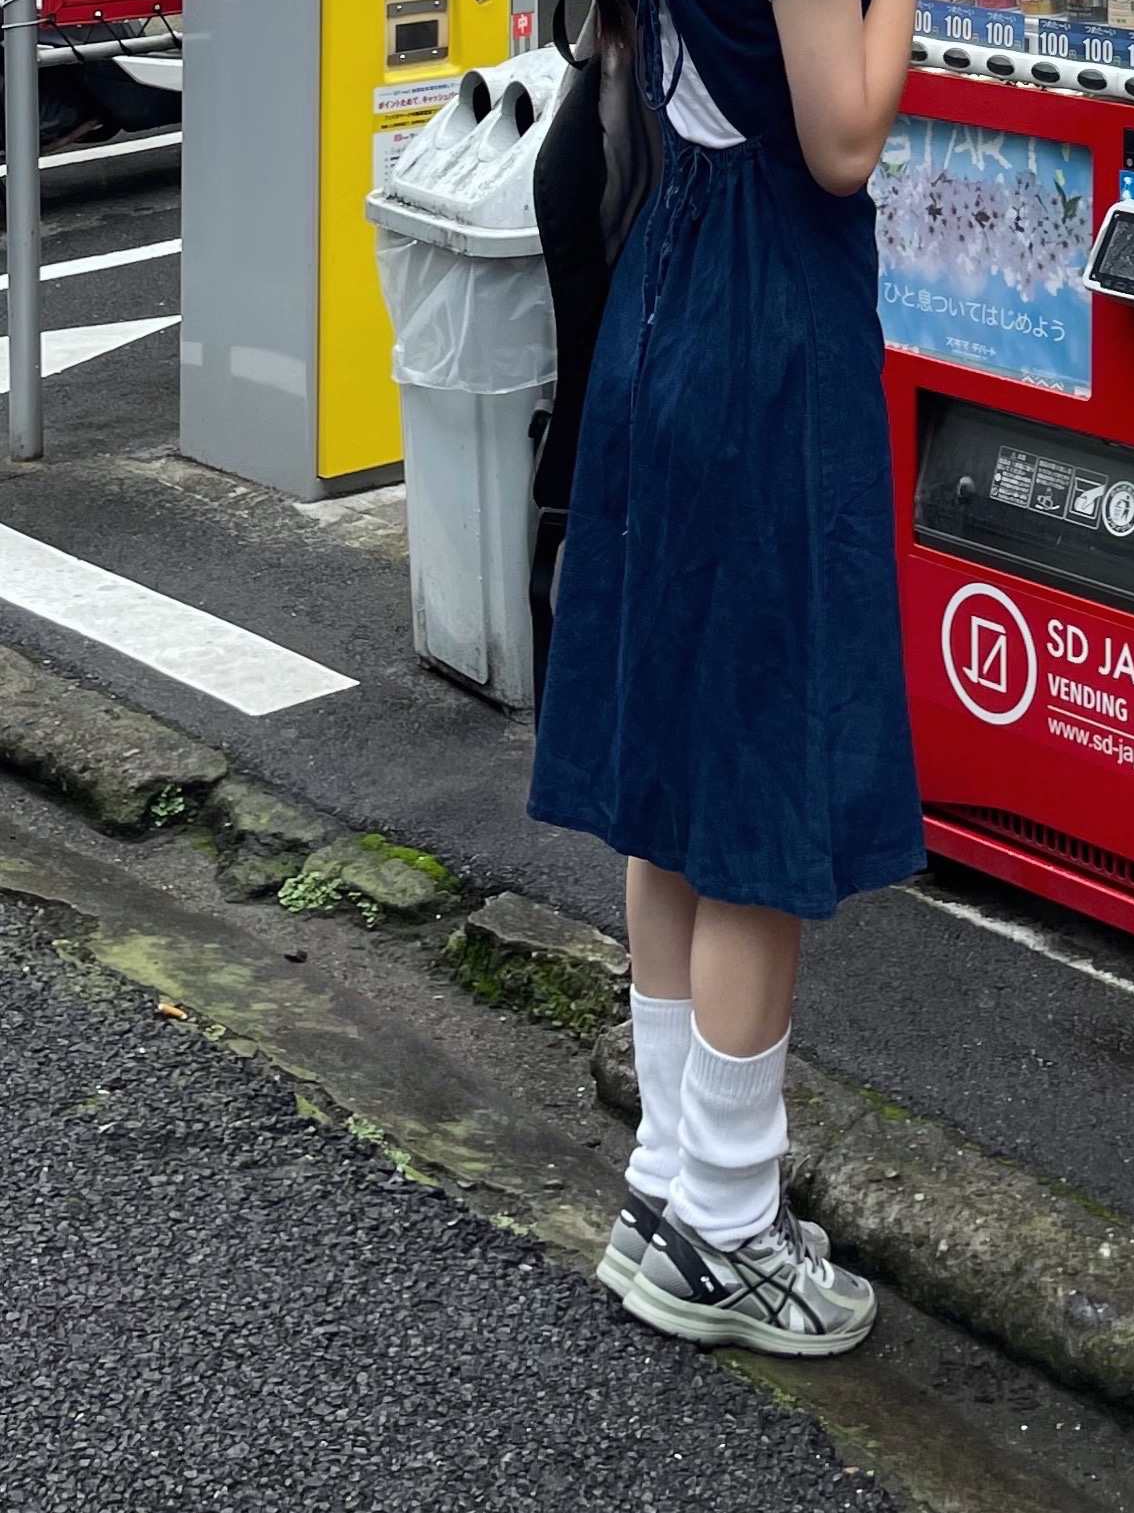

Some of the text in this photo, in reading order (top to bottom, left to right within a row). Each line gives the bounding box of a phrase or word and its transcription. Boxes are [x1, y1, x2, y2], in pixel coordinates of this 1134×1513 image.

[884, 282, 1066, 342] ひと息ついてはじめよう
[1047, 619, 1089, 664] SD
[1047, 673, 1128, 722] VENDING
